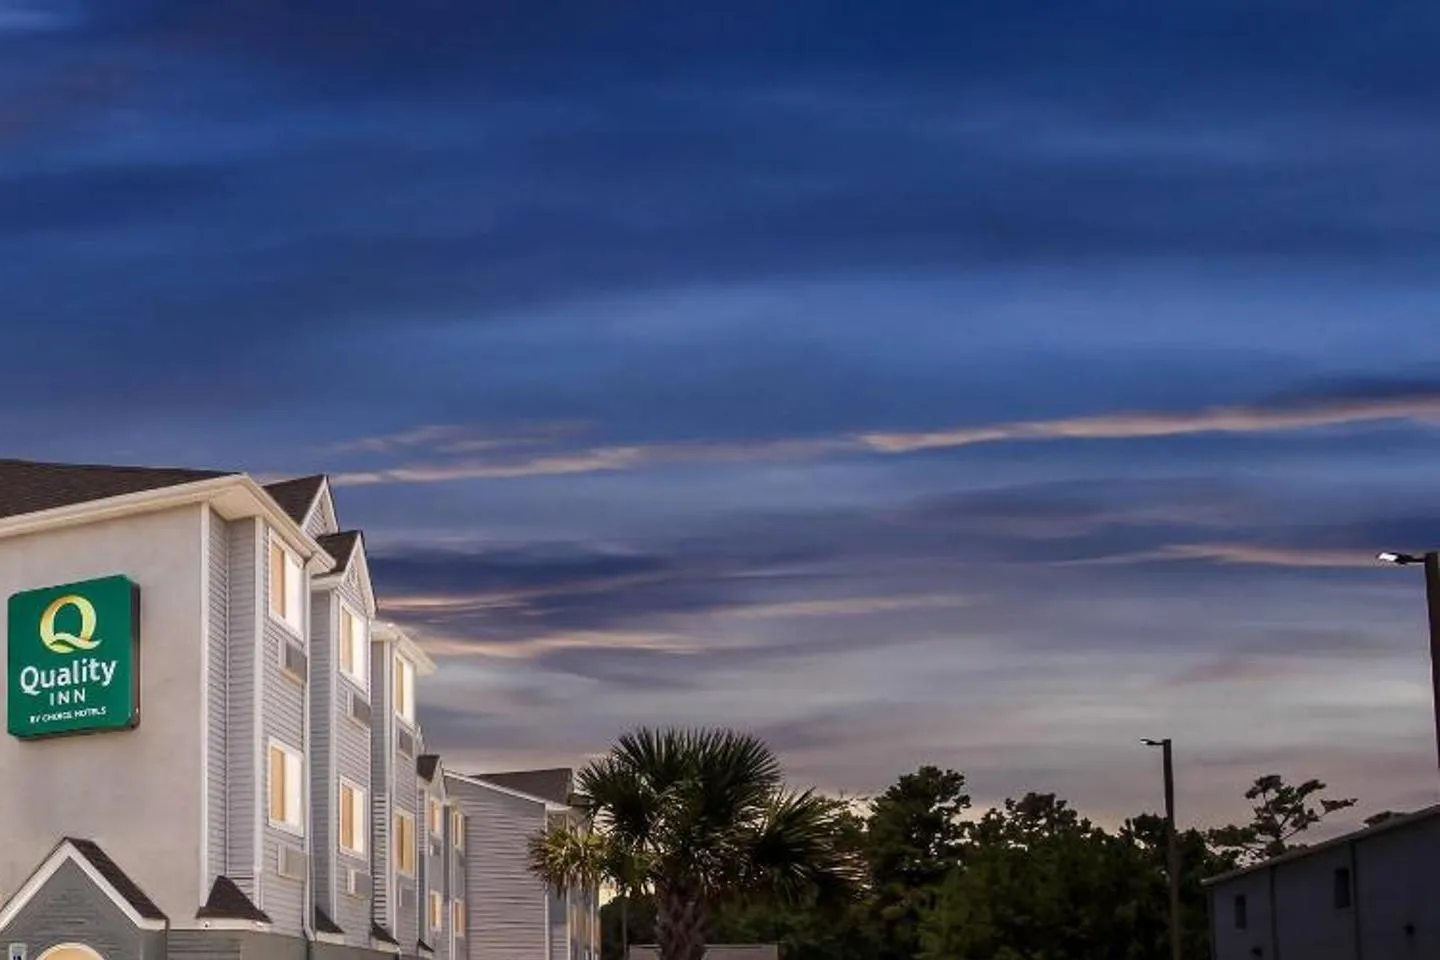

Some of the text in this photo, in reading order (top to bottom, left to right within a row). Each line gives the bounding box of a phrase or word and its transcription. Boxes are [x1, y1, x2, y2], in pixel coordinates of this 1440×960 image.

[40, 594, 102, 654] Q
[20, 658, 117, 696] Quality
[49, 687, 86, 706] INN
